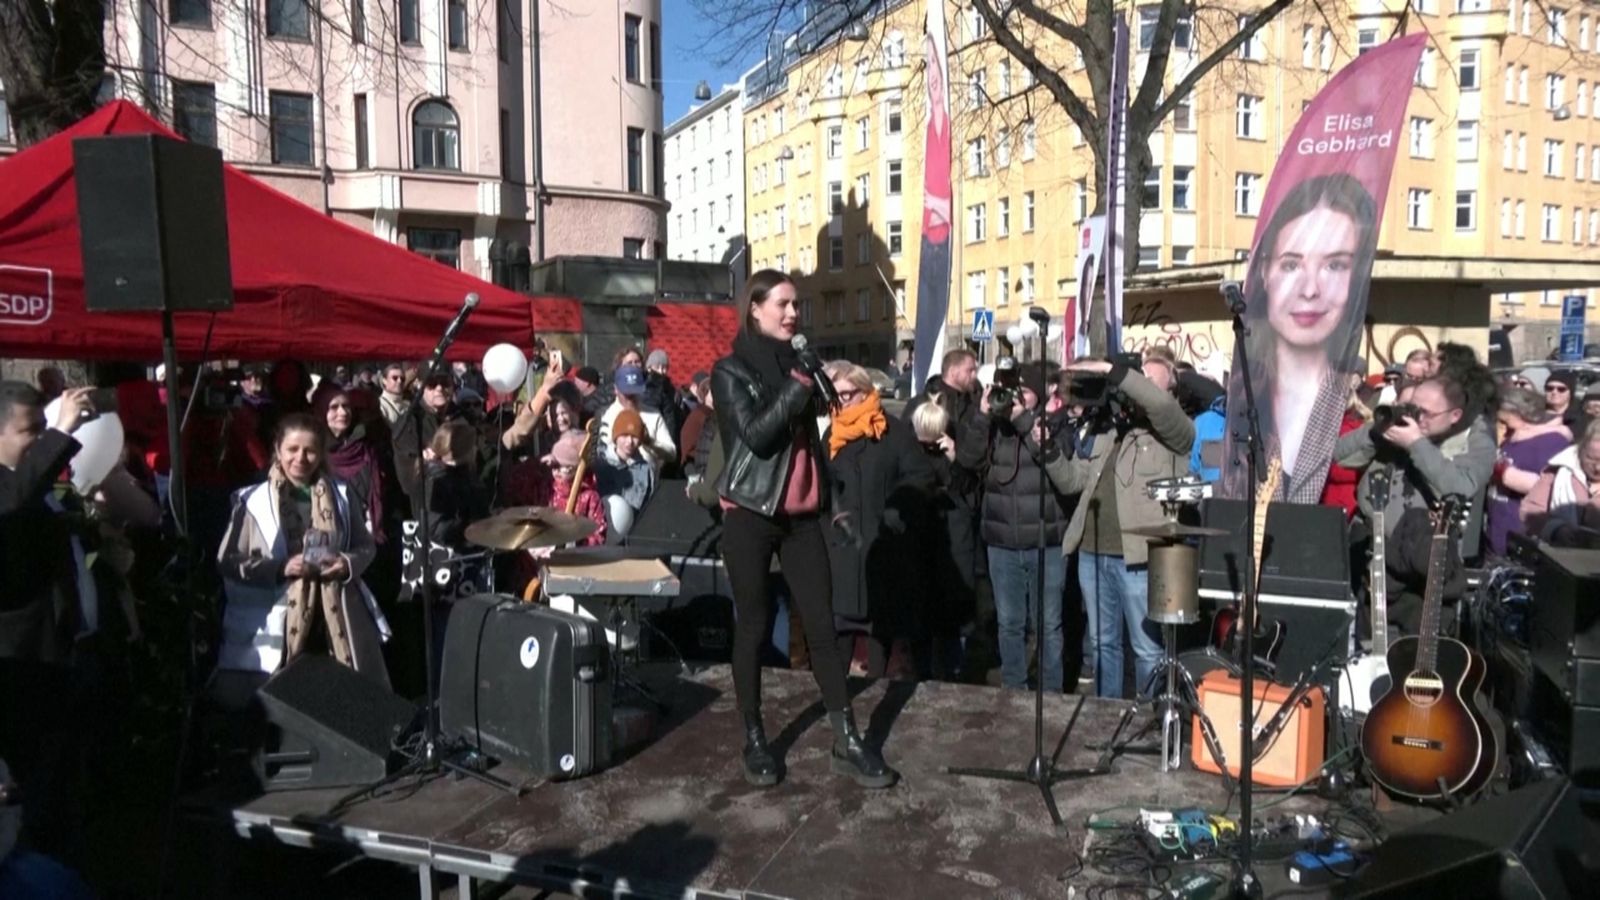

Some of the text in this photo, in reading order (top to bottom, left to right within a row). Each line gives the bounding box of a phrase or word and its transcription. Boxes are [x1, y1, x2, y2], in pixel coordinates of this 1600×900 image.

[1324, 112, 1373, 133] Elisa
[1297, 129, 1393, 155] Gebhard
[0, 293, 44, 316] SDP
[1567, 297, 1583, 316] P
